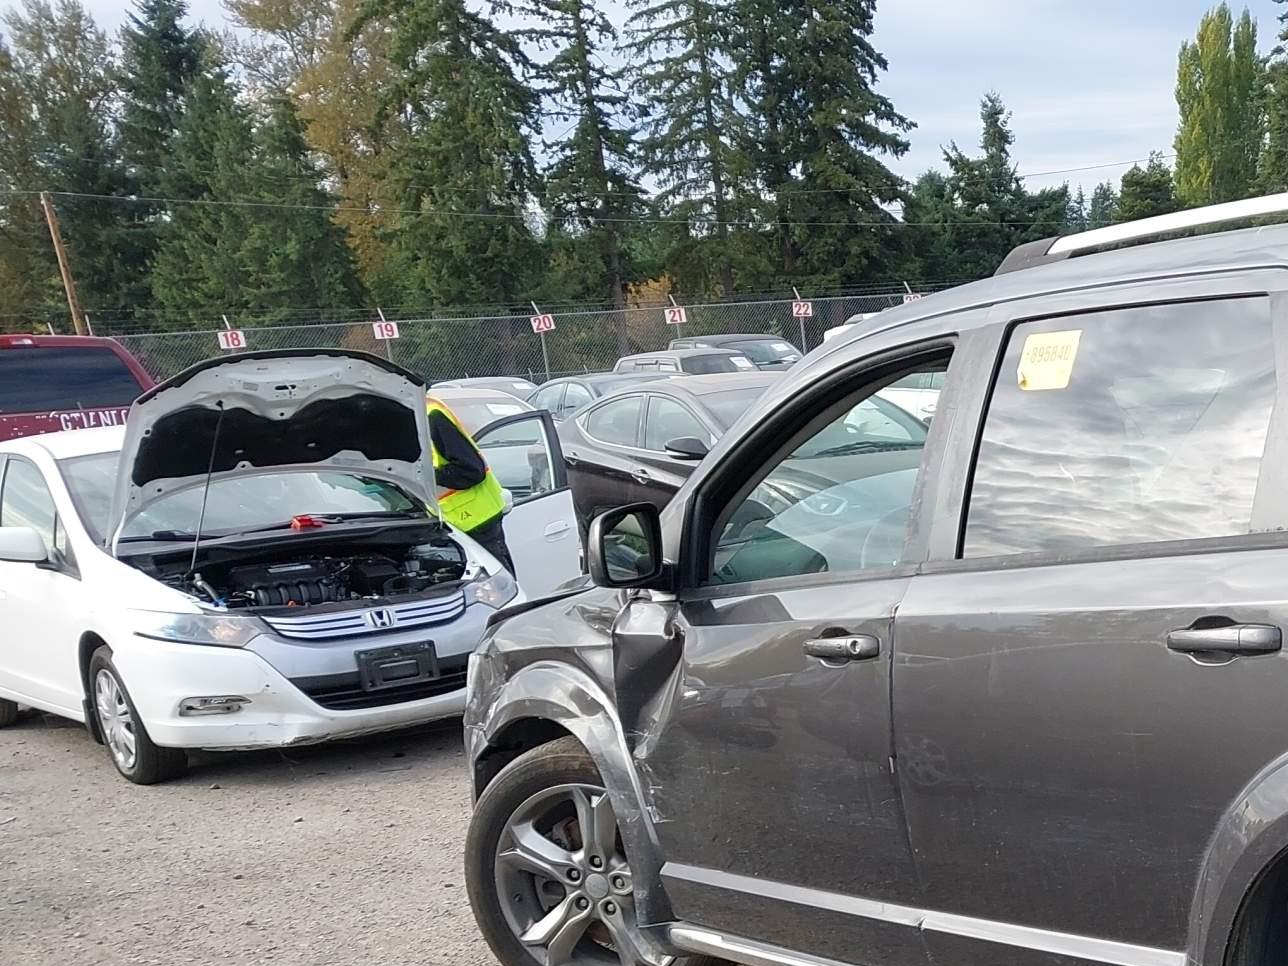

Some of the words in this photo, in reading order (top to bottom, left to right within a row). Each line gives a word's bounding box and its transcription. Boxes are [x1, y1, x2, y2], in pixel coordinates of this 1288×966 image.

[668, 309, 683, 323] 21
[794, 303, 810, 316] 22
[377, 323, 395, 338] 19
[533, 316, 552, 331] 20
[222, 332, 241, 347] 18
